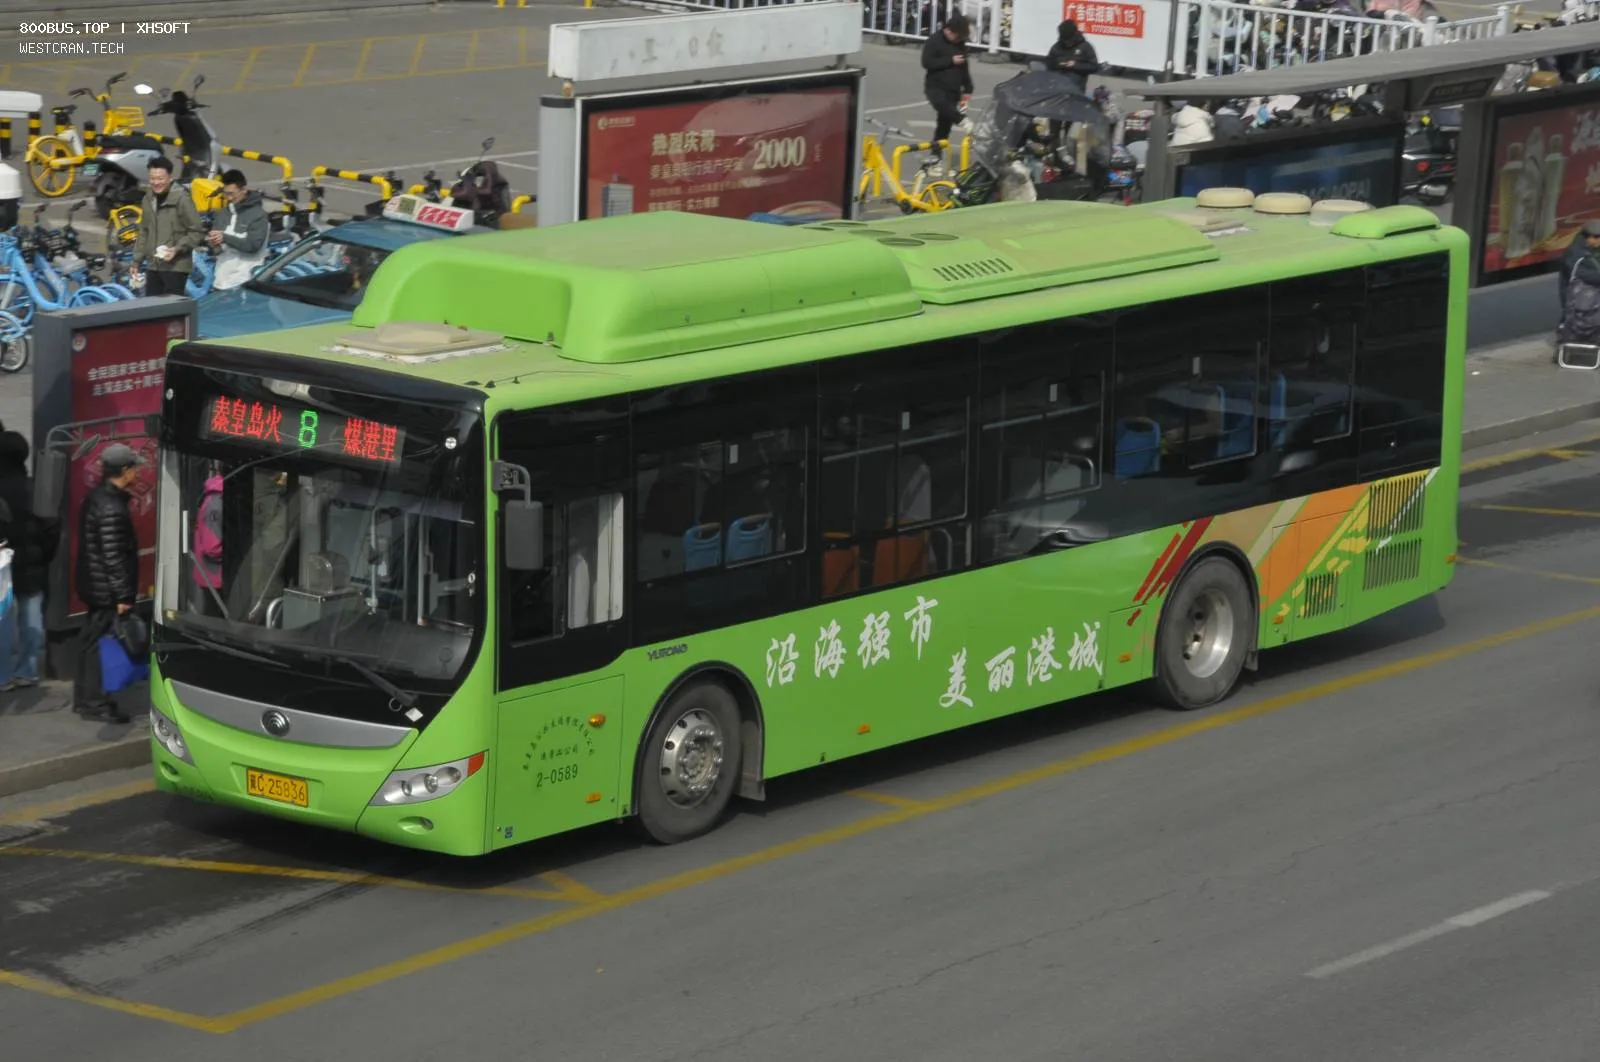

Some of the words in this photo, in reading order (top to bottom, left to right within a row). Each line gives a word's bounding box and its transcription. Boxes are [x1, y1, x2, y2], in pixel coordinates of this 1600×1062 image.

[752, 136, 806, 170] 2000
[210, 395, 283, 444] 秦皇岛火
[299, 410, 319, 448] 8
[766, 595, 938, 688] 沿海强市
[938, 621, 1104, 708] 美丽港城
[536, 764, 578, 788] 2-0589
